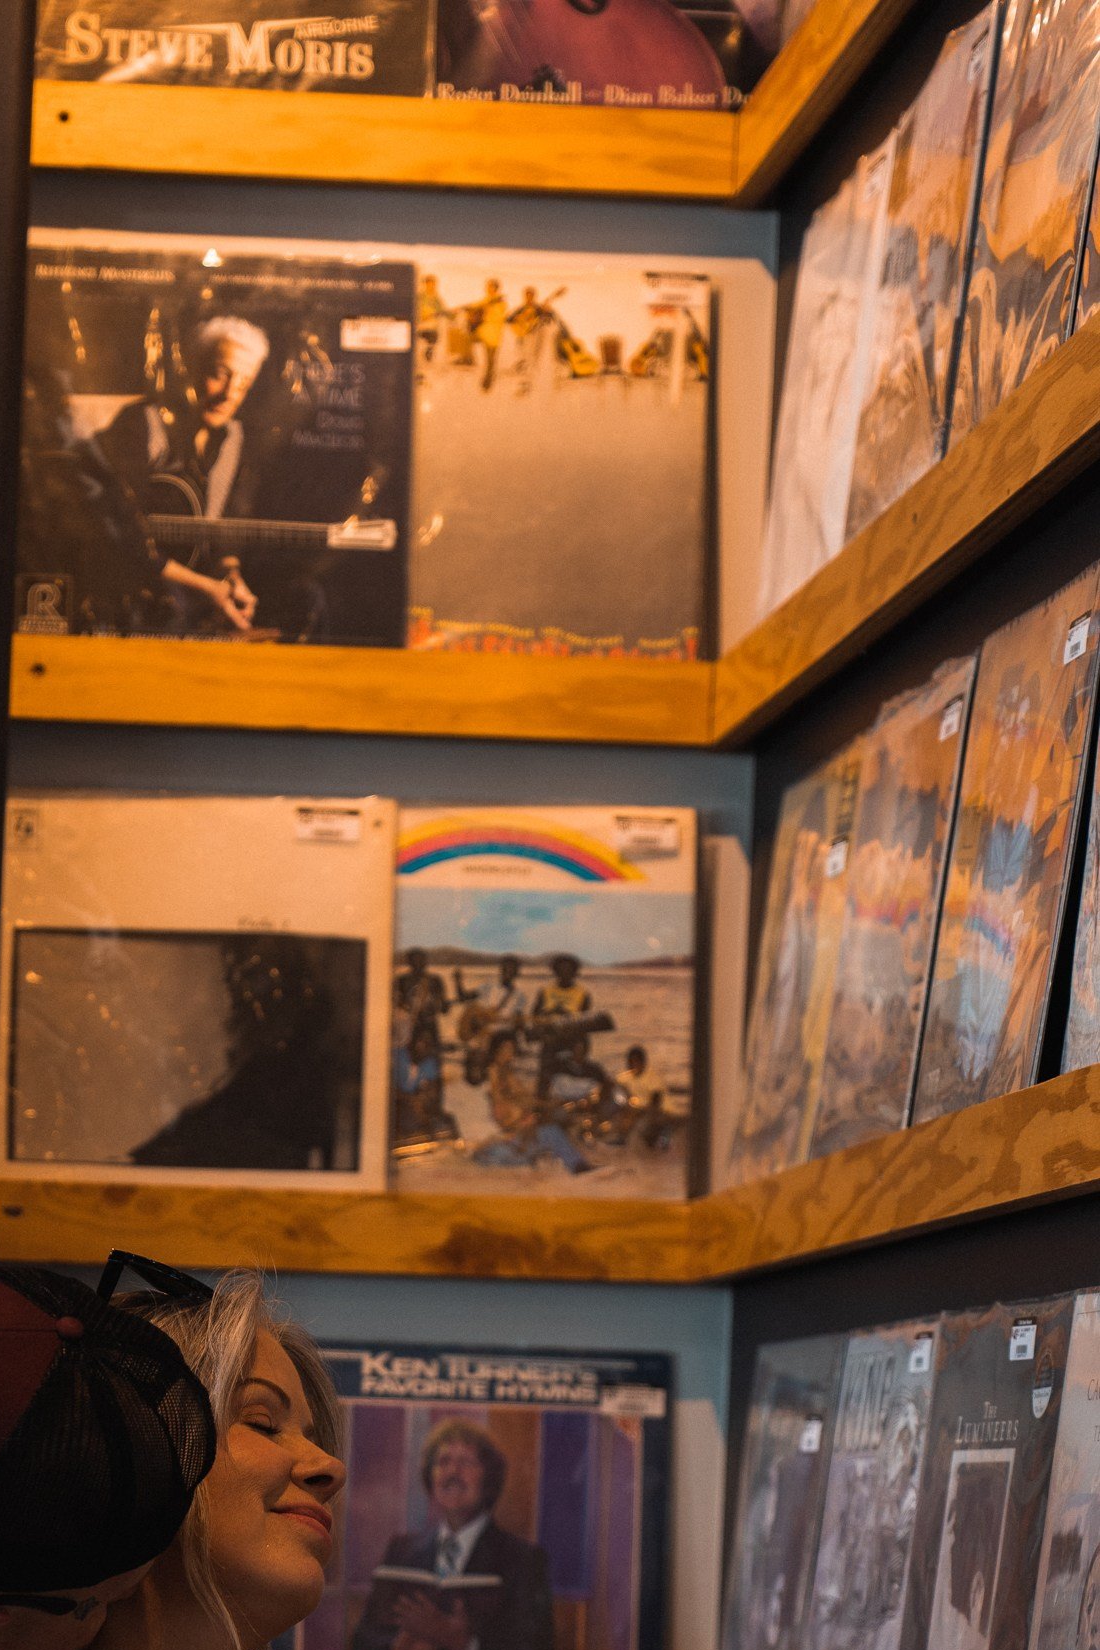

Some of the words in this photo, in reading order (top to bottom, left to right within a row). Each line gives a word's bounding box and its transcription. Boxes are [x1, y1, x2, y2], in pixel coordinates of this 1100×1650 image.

[65, 12, 212, 68] STEVE
[226, 18, 375, 80] MORIS
[360, 1353, 439, 1379] KEN
[955, 1415, 1020, 1444] LUMINEERS
